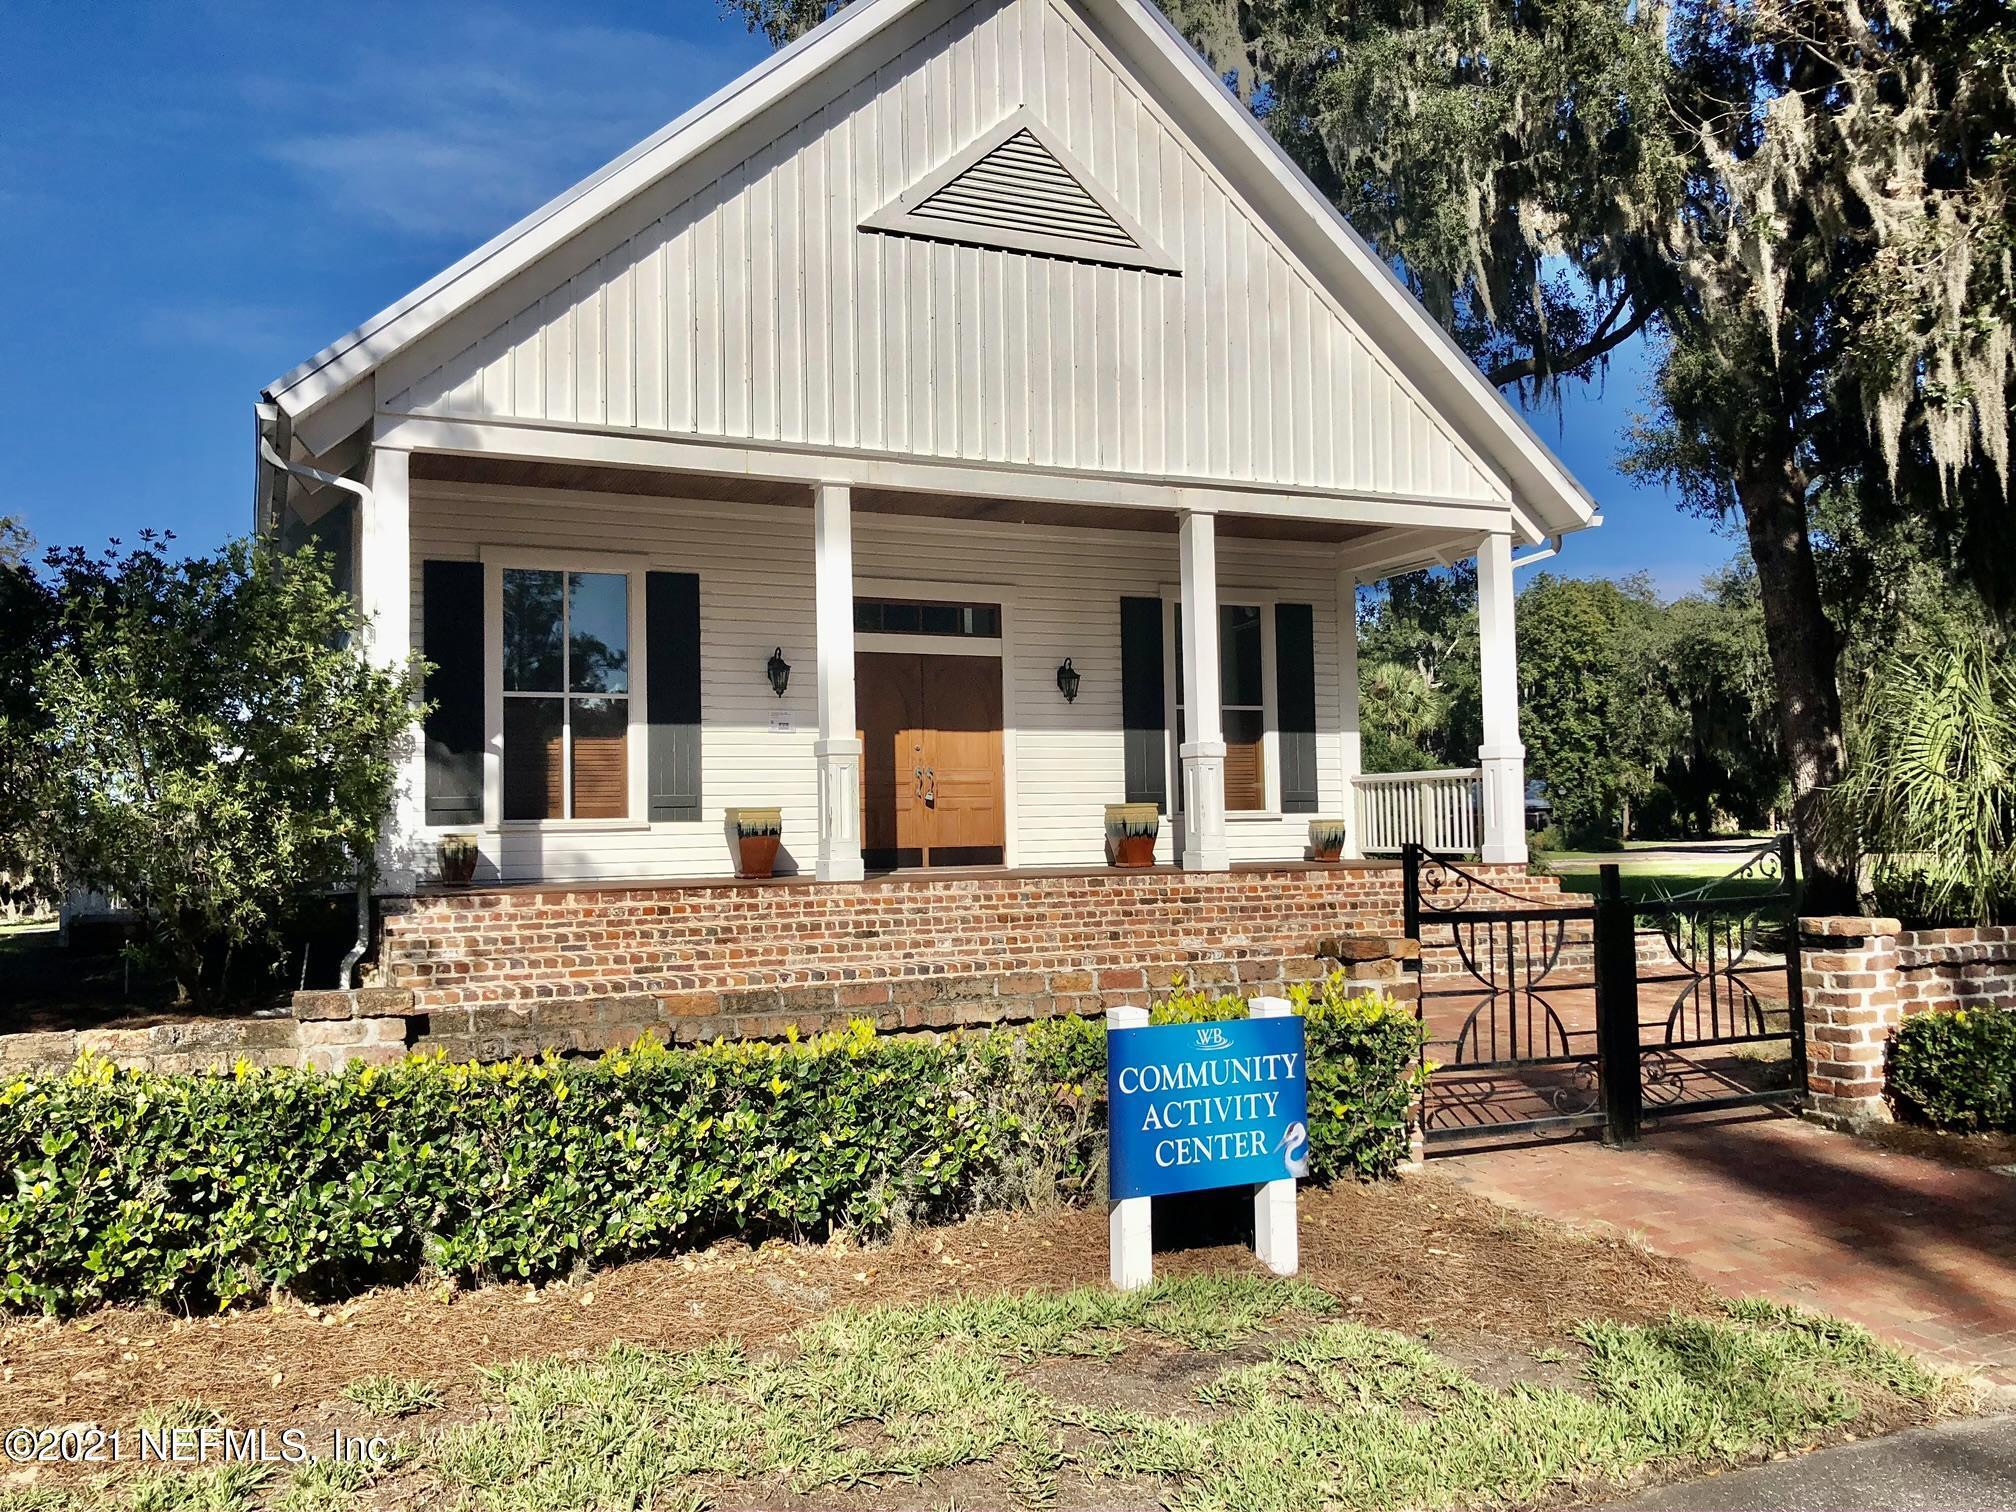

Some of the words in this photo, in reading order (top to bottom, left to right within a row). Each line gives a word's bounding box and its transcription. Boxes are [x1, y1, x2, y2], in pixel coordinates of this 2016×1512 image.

[1118, 1052, 1298, 1094] COMMUNITY
[1141, 1091, 1279, 1131] ACTIVITY
[1155, 1130, 1268, 1167] CENTER
